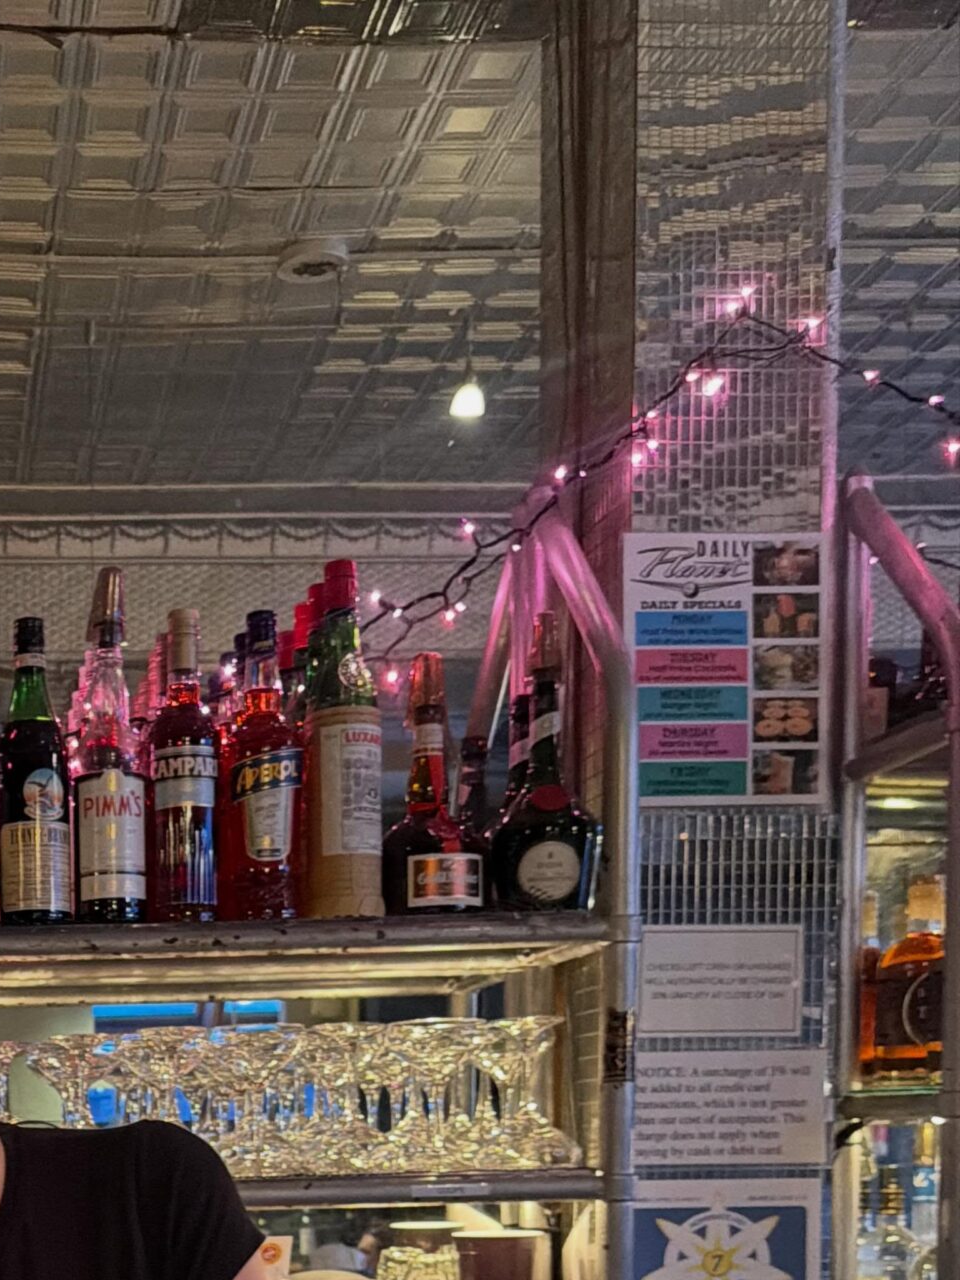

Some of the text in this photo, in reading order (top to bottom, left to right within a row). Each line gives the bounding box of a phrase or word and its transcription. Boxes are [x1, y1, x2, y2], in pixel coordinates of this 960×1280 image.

[696, 540, 751, 558] DAILY
[640, 599, 743, 610] DAILY SPECIALS
[150, 755, 219, 783] CAMPARI
[235, 758, 300, 794] APEROL
[82, 790, 142, 820] PIMM'S
[690, 1067, 699, 1077] A
[754, 1066, 767, 1076] of
[790, 1065, 811, 1076] will
[650, 1083, 683, 1094] added
[685, 1085, 696, 1093] to
[698, 1083, 712, 1093] all
[747, 1081, 771, 1092] card
[703, 1098, 735, 1109] which
[750, 1099, 767, 1108] not
[703, 1114, 716, 1124] of
[783, 1112, 806, 1124] This
[698, 1131, 716, 1140] not
[718, 1129, 746, 1142] apply
[670, 1147, 684, 1159] by
[711, 1253, 723, 1272] 7
